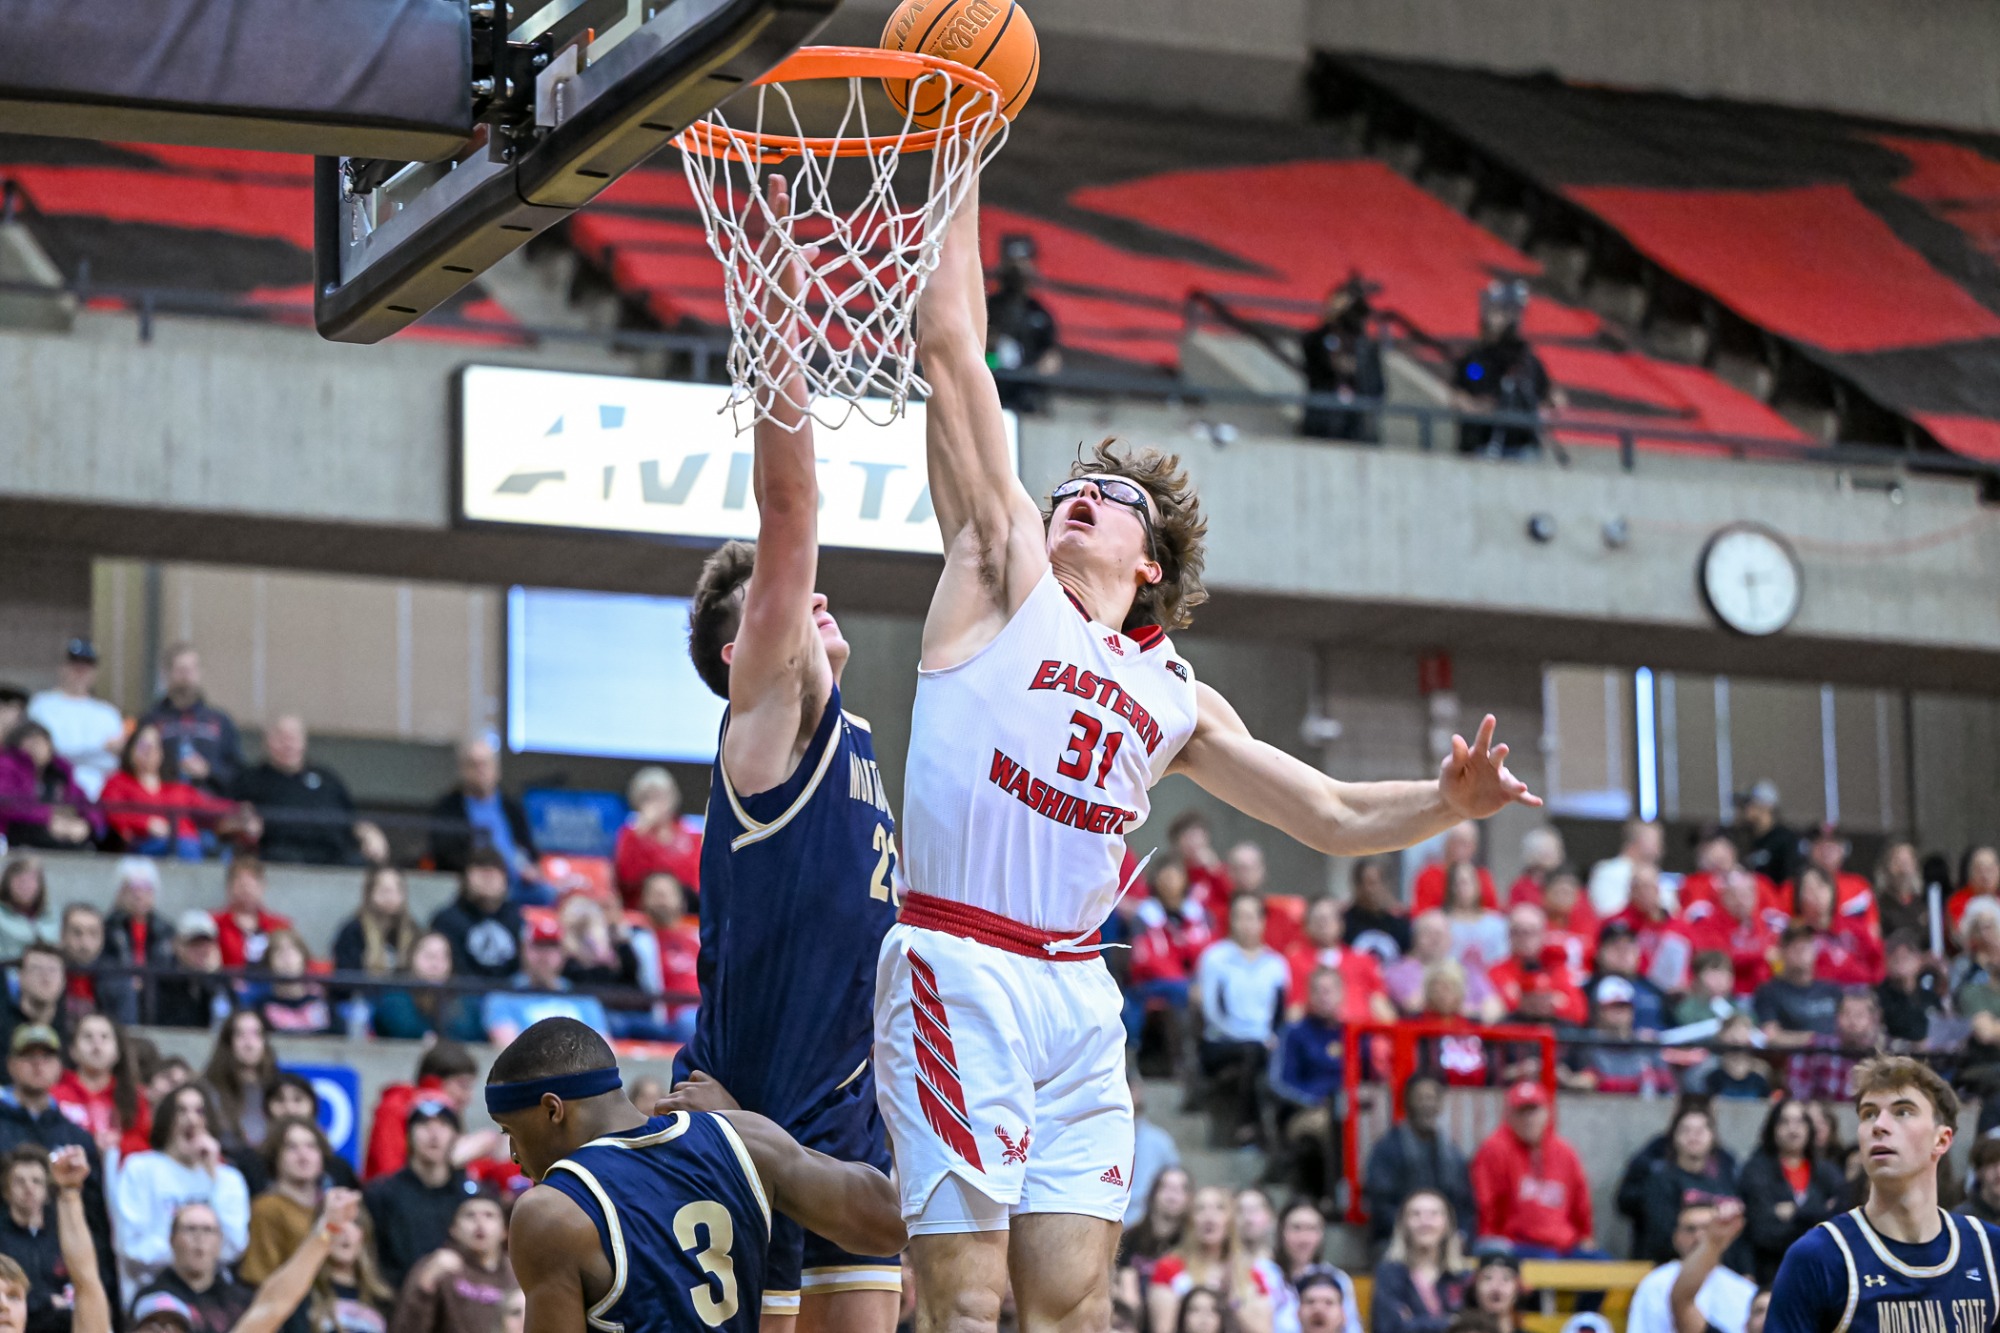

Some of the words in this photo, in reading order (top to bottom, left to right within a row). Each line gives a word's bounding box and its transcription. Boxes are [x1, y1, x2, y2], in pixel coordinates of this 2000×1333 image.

[930, 0, 1002, 60] Wils
[493, 404, 934, 524] AVIT
[1027, 659, 1164, 758] EASTERN
[1056, 709, 1124, 791] 31
[988, 747, 1138, 835] WASHINGT
[1100, 1175, 1124, 1187] adidas
[672, 1200, 739, 1328] 3
[1877, 1299, 1949, 1333] MONTANA
[1951, 1298, 1988, 1333] STATE
